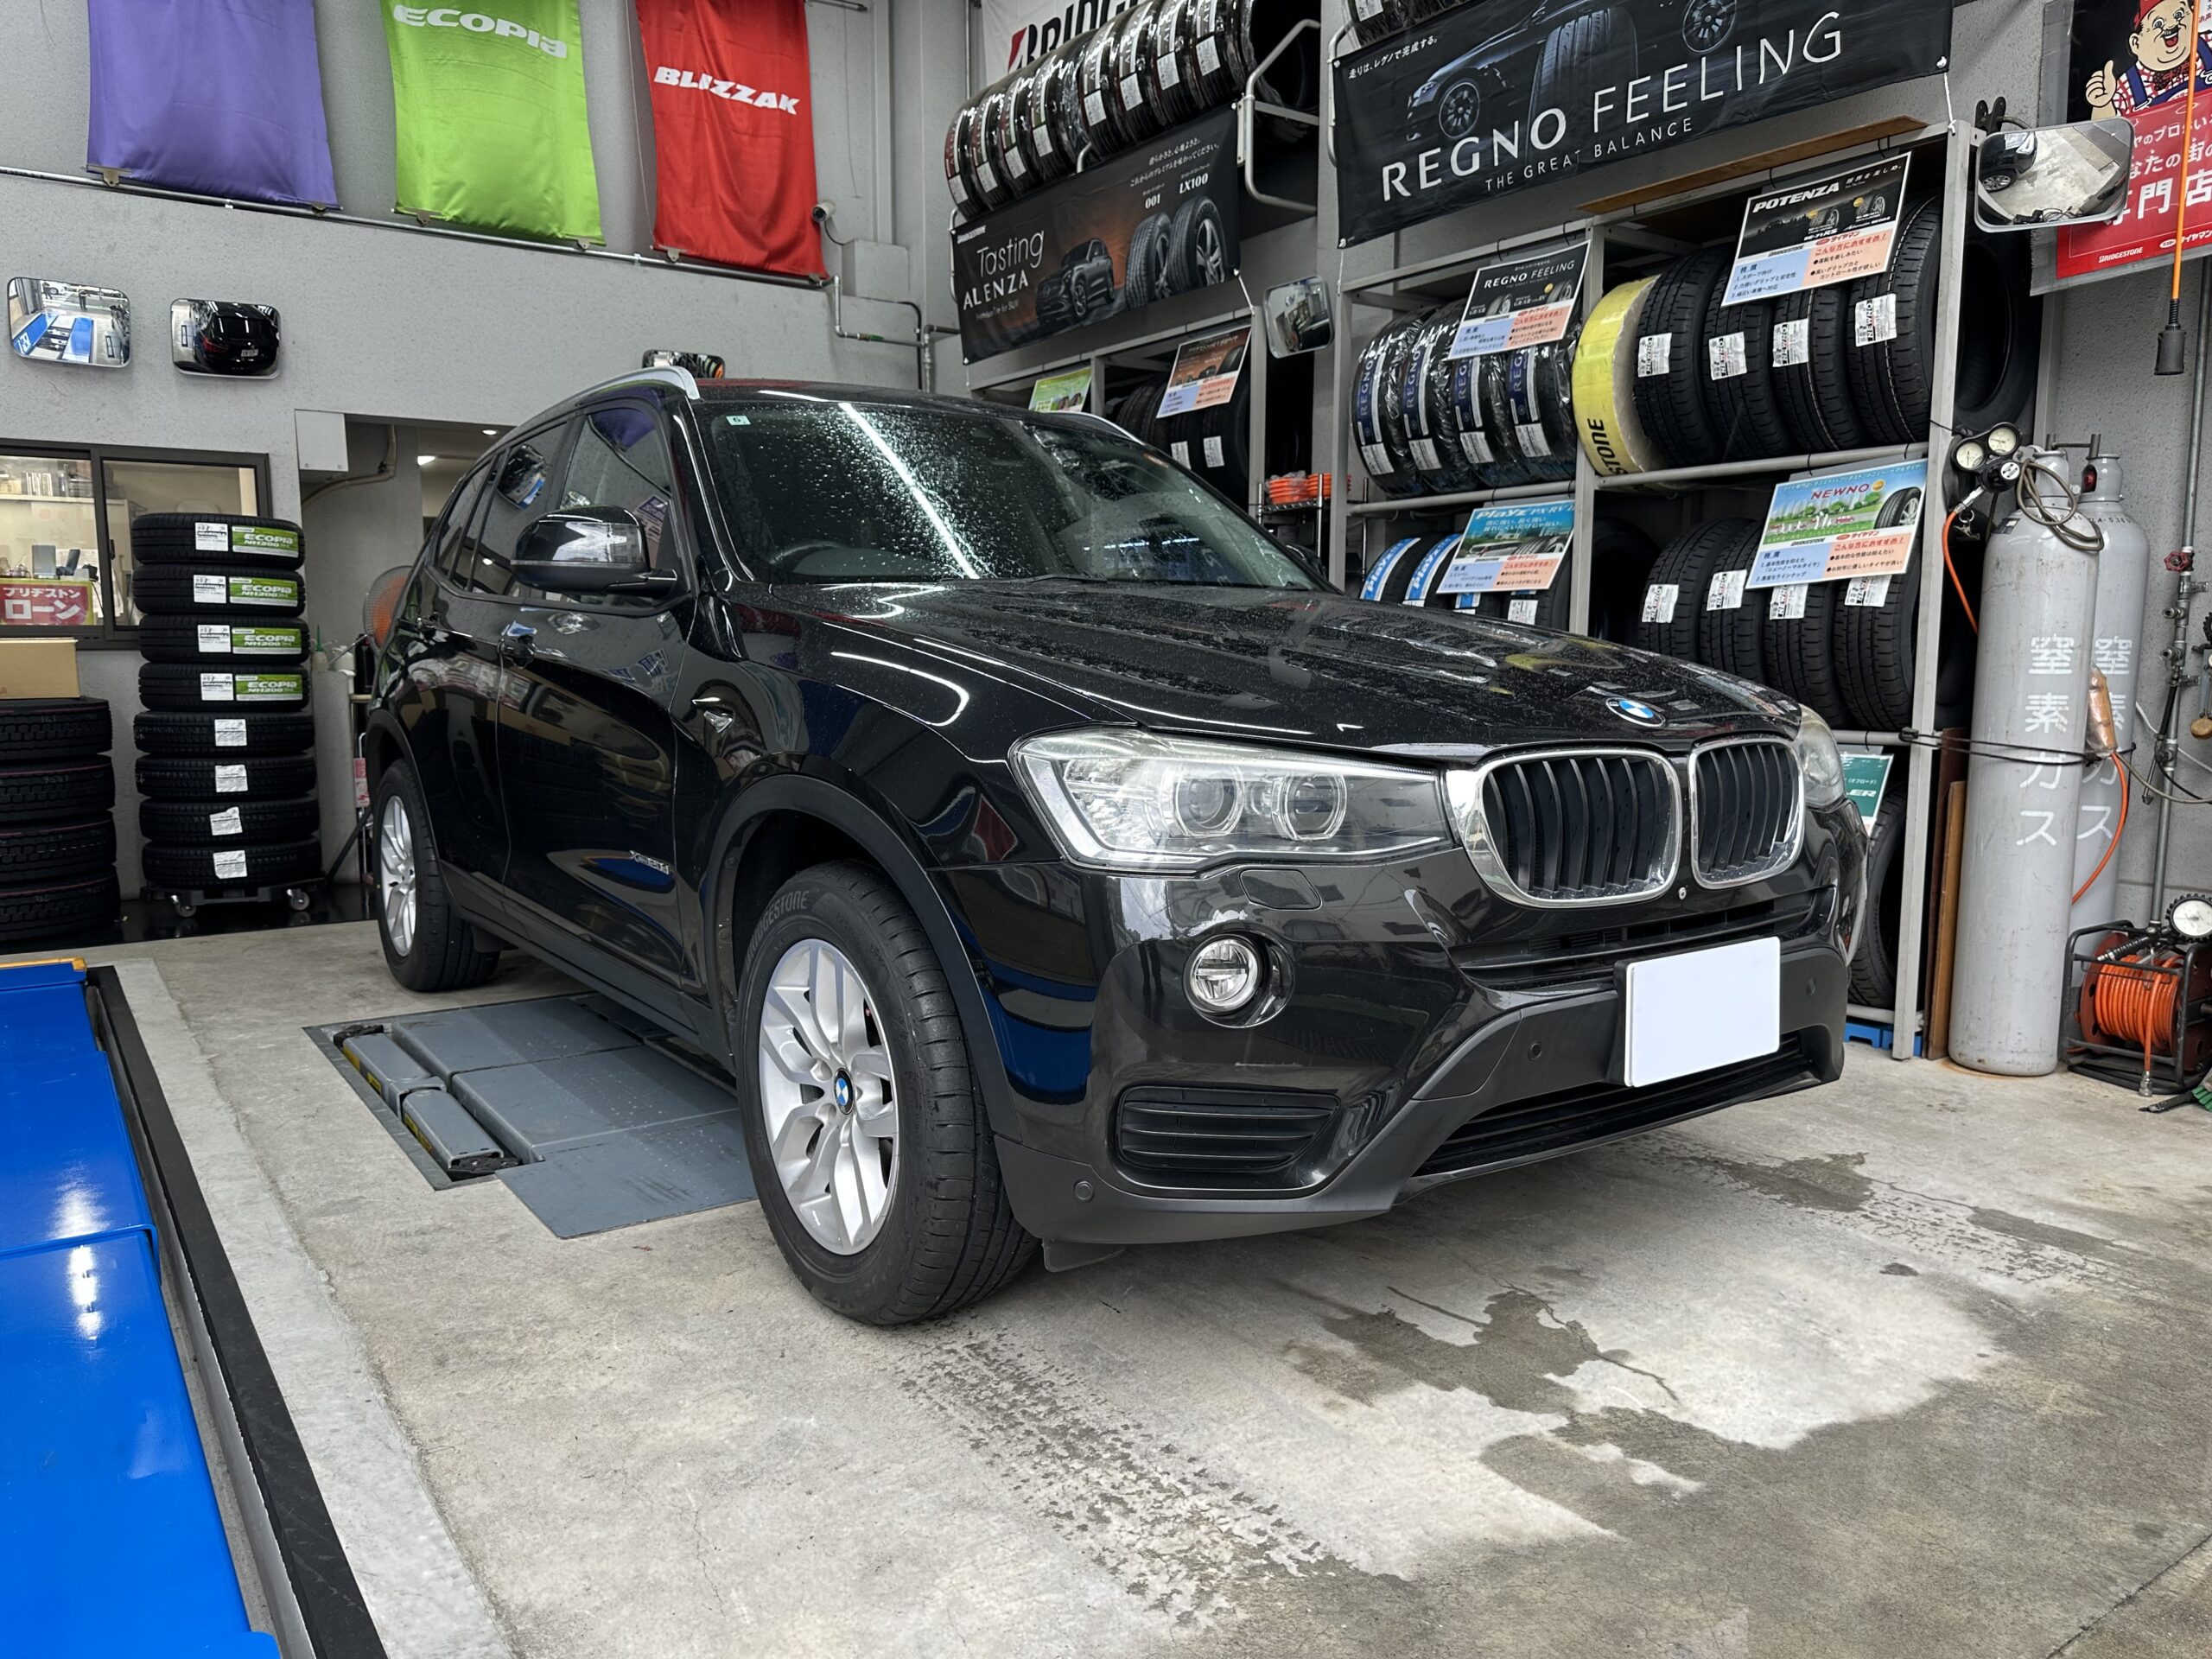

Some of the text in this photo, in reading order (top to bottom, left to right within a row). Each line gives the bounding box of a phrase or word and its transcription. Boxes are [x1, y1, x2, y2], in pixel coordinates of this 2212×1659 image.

[393, 3, 567, 59] ECOPIA
[1349, 35, 1438, 79] 走りは、レグノで完成する。
[653, 66, 800, 116] BLIZZAK
[1382, 11, 1842, 201] REGNO FEELING
[1485, 172, 1514, 192] THE
[1594, 118, 1693, 158] BALANCE
[1145, 193, 1161, 209] 001
[1179, 172, 1209, 194] LX100
[1752, 182, 1840, 213] POTENZA
[976, 230, 1044, 278] Tasting
[1484, 260, 1575, 289] REGNO FEELING
[2099, 246, 2143, 263] BRIDGESTONE
[963, 270, 1028, 310] ALENZA
[1359, 360, 1374, 416] REGNO
[1406, 350, 1421, 409] REGNO
[1458, 358, 1468, 399] REG
[1512, 350, 1523, 392] REG
[1587, 418, 1628, 474] STONE
[1810, 483, 1870, 500] NEWNO
[1476, 509, 1529, 519] Playz
[3, 587, 80, 598] ブリヂストン
[4, 600, 80, 620] ローン
[2016, 633, 2075, 846] 窒素ガス
[1847, 789, 1877, 798] ER
